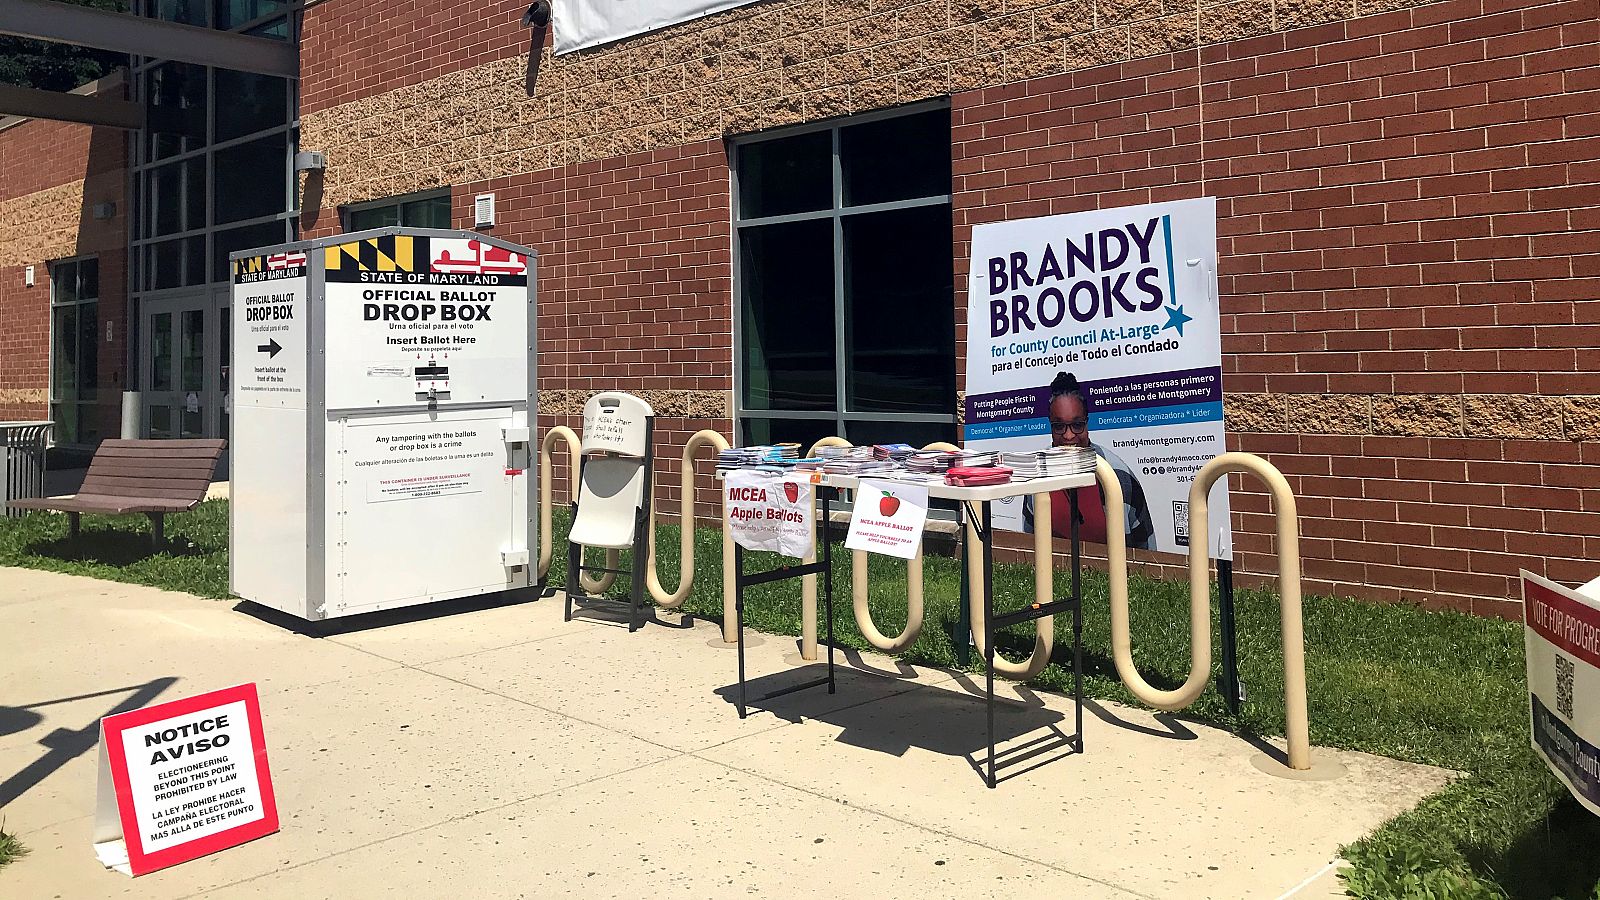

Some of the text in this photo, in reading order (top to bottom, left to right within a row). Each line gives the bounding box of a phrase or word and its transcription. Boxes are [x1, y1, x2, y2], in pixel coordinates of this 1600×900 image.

[988, 216, 1160, 296] BRANDY
[242, 268, 299, 283] STATE OF MARYLAND
[360, 272, 499, 285] STATE OF MARYLAND
[246, 292, 295, 306] OFFICIAL BALLOT
[362, 289, 497, 302] OFFICIAL BALLOT
[990, 267, 1163, 338] BROOKS
[246, 304, 294, 322] DROP BOX
[364, 303, 492, 322] DROP BOX
[389, 322, 406, 330] Urna
[408, 322, 431, 330] oficial
[386, 336, 476, 345] Insert Ballot Here
[991, 323, 1160, 358] for County Council At-Large
[991, 338, 1179, 375] para el Concejo de Todo el Condado
[1089, 384, 1123, 396] Poniendo
[1130, 382, 1142, 391] las
[1143, 379, 1179, 391] personas
[1180, 374, 1215, 387] primero
[974, 394, 1036, 409] Putting People First in
[1105, 396, 1112, 405] el
[1113, 394, 1146, 404] condado
[1146, 392, 1157, 402] de
[1158, 386, 1211, 399] Montgomery
[976, 406, 1034, 418] Montgomery County
[1098, 414, 1133, 426] Demócrata
[1139, 411, 1185, 422] Organizadora
[376, 430, 477, 444] Any tampering with the ballots
[970, 422, 1047, 435] Democrat Organizer Leader
[398, 443, 415, 452] drop
[416, 442, 429, 450] box
[444, 440, 462, 448] crime
[1112, 434, 1216, 448] brandy4montgomery.com
[354, 458, 381, 468] Cualquier
[408, 456, 415, 464] de
[424, 454, 444, 462] boletas
[729, 488, 767, 502] MCEA
[730, 506, 804, 524] Apple Ballots
[860, 518, 874, 526] MCEA
[892, 524, 914, 532] BALLOT
[1532, 598, 1600, 656] VOTE FOR PROGRE
[144, 714, 230, 748] NOTICE
[150, 734, 230, 766] AVISO
[158, 755, 229, 780] ELECTIONEERING
[154, 762, 236, 792] BEYOND THIS POINT
[154, 772, 238, 802] PROHIBITED BY LAW
[152, 786, 246, 820] LA LEY PROHIBE HACER
[157, 798, 246, 829] CAMPAÑA ELECTORAL
[150, 804, 254, 842] MAS ALLA DE ESTE PUNTO
